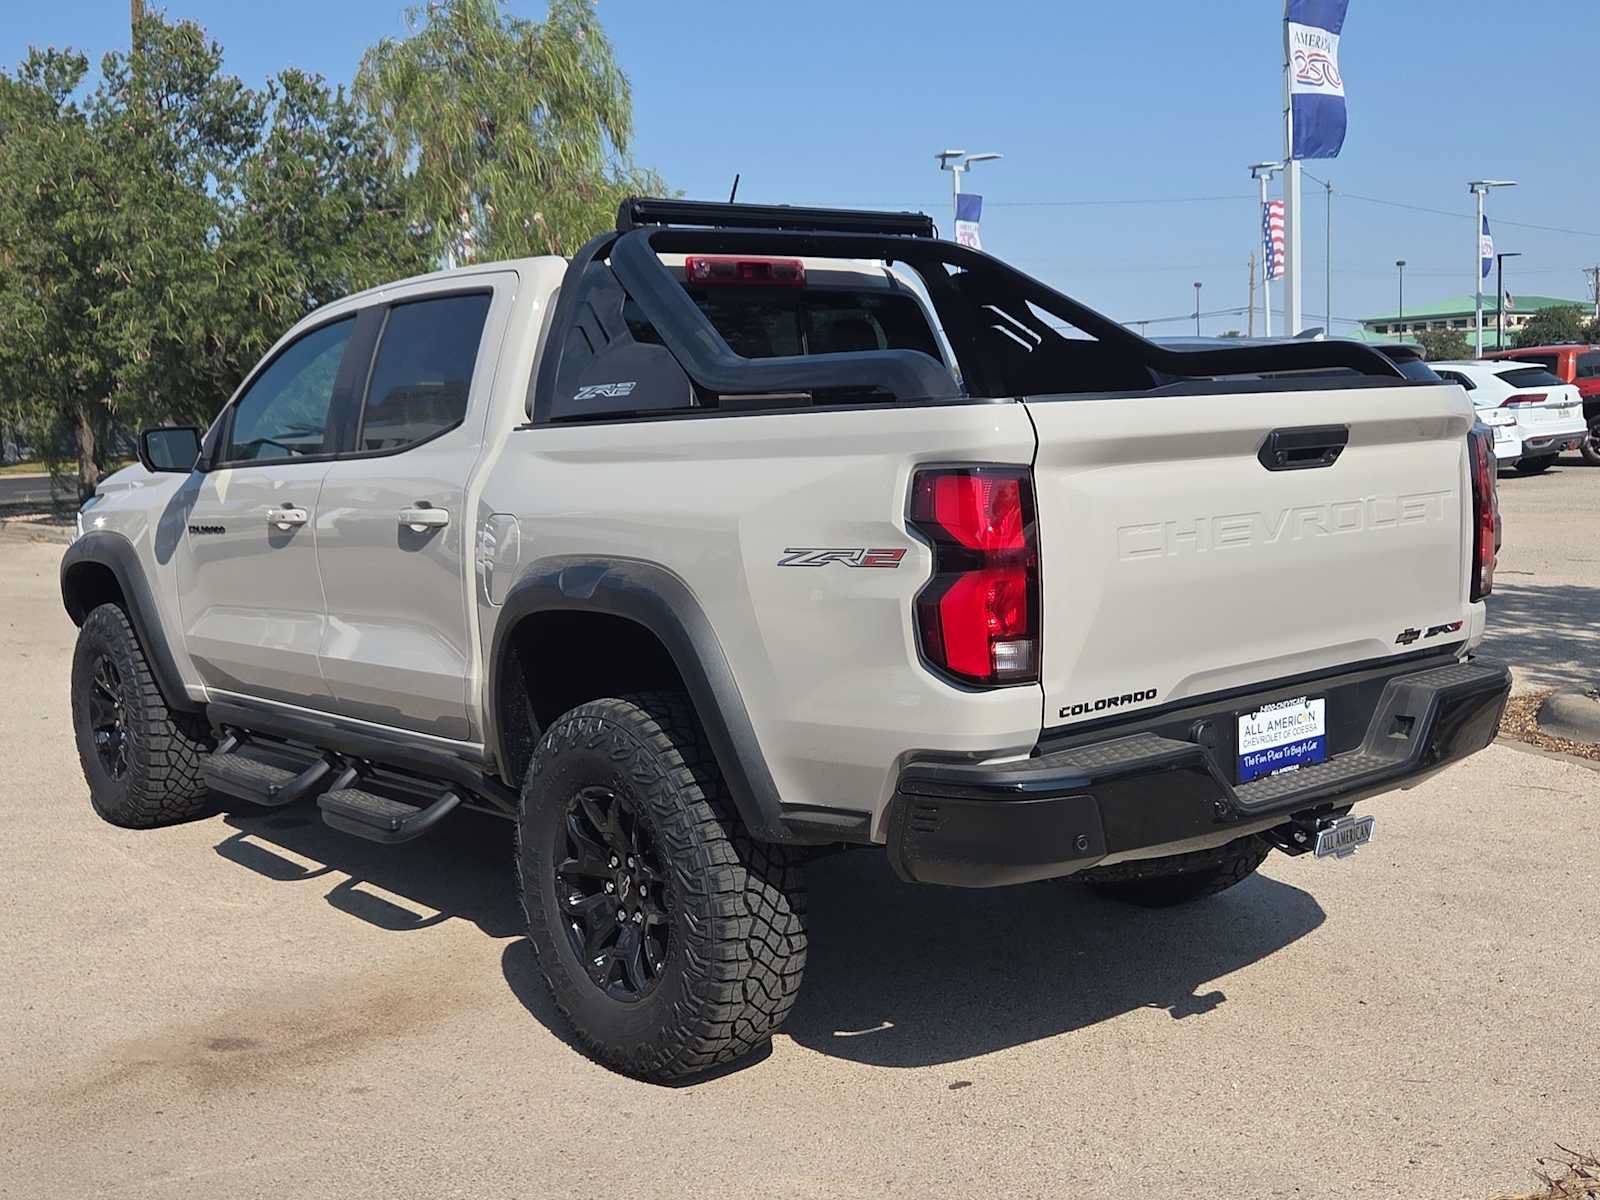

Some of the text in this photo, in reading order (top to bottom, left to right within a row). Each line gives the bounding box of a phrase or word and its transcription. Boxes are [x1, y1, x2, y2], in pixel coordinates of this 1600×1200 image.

[573, 381, 637, 400] ZR2
[1116, 489, 1452, 561] CHEVROLET
[776, 547, 907, 568] ZR2
[1059, 688, 1157, 718] COLORADO
[1242, 723, 1318, 748] CHEVROLET OF ODESSA
[1244, 710, 1316, 736] ALL AMERICAN
[1244, 755, 1255, 767] The
[1255, 753, 1267, 764] Fun
[1290, 745, 1302, 757] Buy
[1302, 743, 1307, 753] A
[1307, 740, 1318, 750] Car
